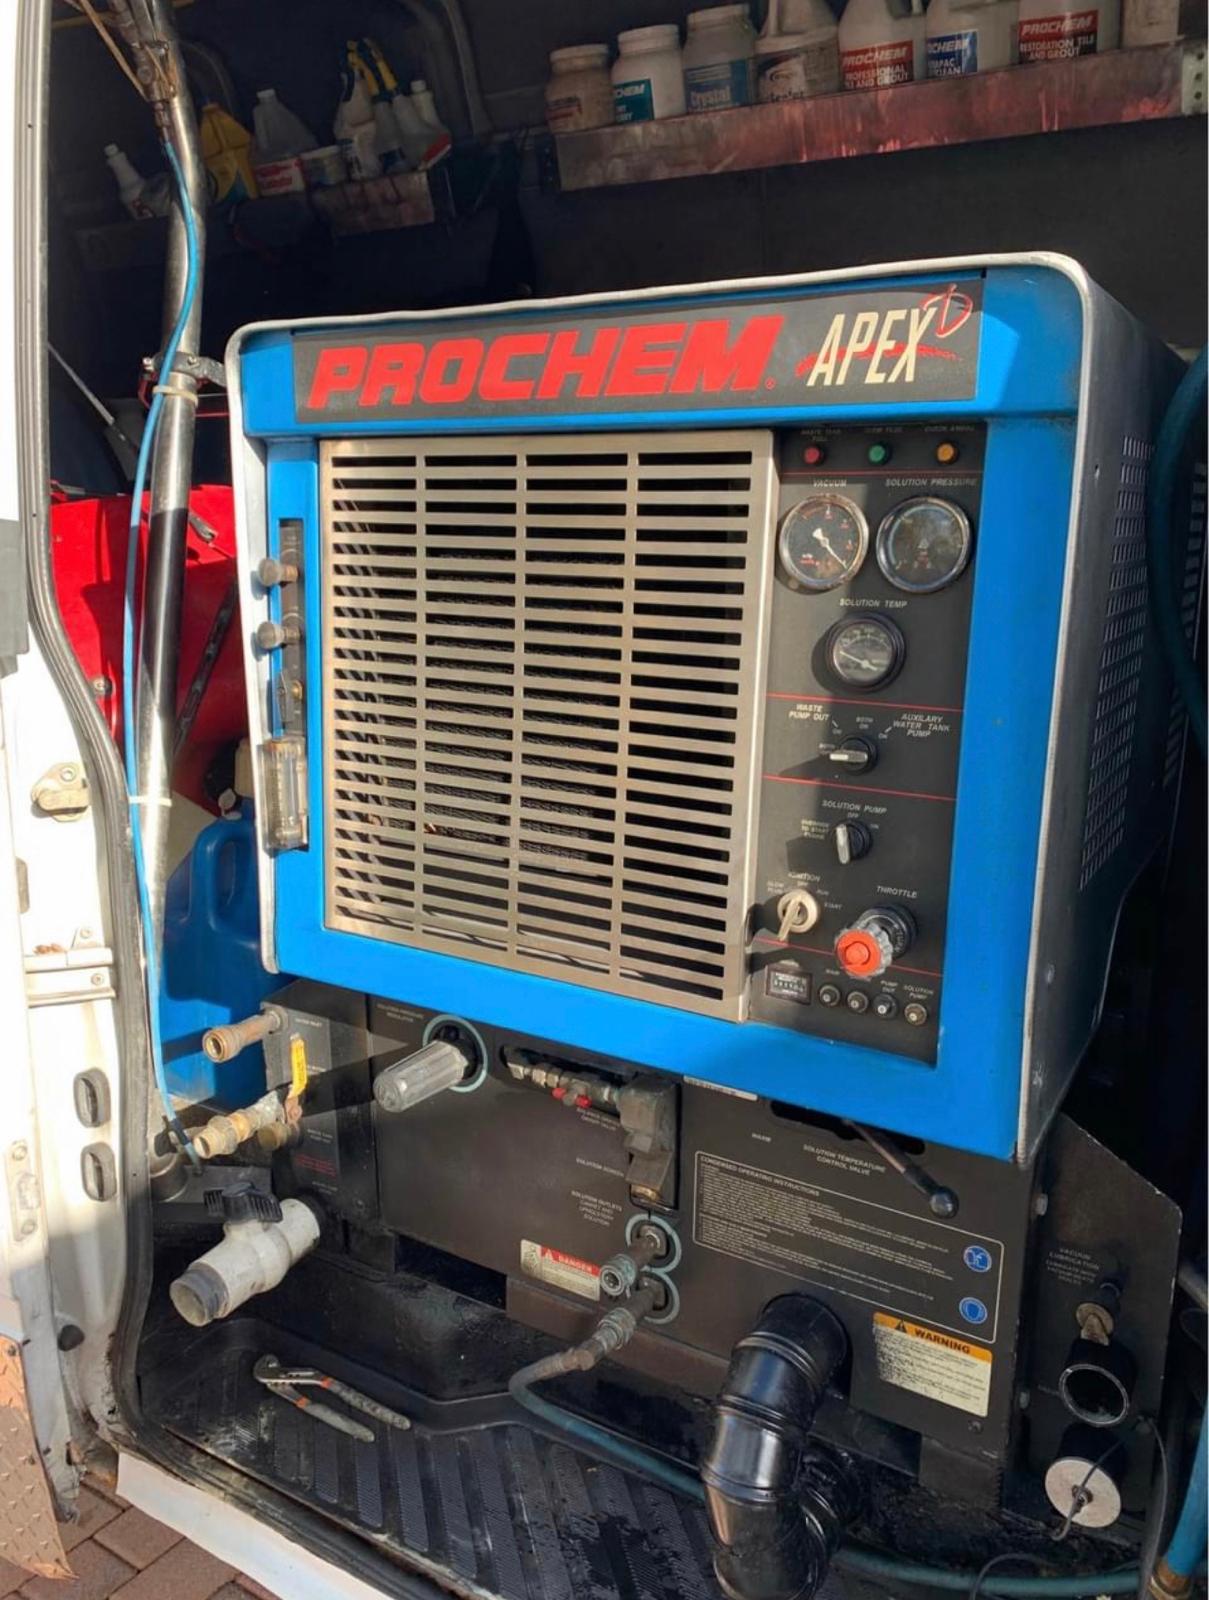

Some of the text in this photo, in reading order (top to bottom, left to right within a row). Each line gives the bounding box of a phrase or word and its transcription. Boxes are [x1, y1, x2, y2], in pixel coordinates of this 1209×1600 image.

[1021, 14, 1093, 36] PROCHEM
[306, 315, 783, 408] PROCHEM
[806, 306, 918, 387] APEX
[813, 479, 848, 488] VACUUM
[886, 478, 977, 487] SOLUTION PRESSURE
[839, 597, 908, 609] SOLUTION TEMP
[796, 703, 823, 712] WASTE
[788, 710, 830, 721] PUMP OUT
[901, 713, 944, 723] AUXILARY
[893, 720, 951, 732] WATER TANK
[906, 729, 931, 738] PUMP
[821, 799, 888, 814] SOLUTION PUMP
[876, 885, 918, 899] THROTTLE
[837, 1153, 887, 1173] TEMPERATURE
[914, 1326, 971, 1355] WARNING
